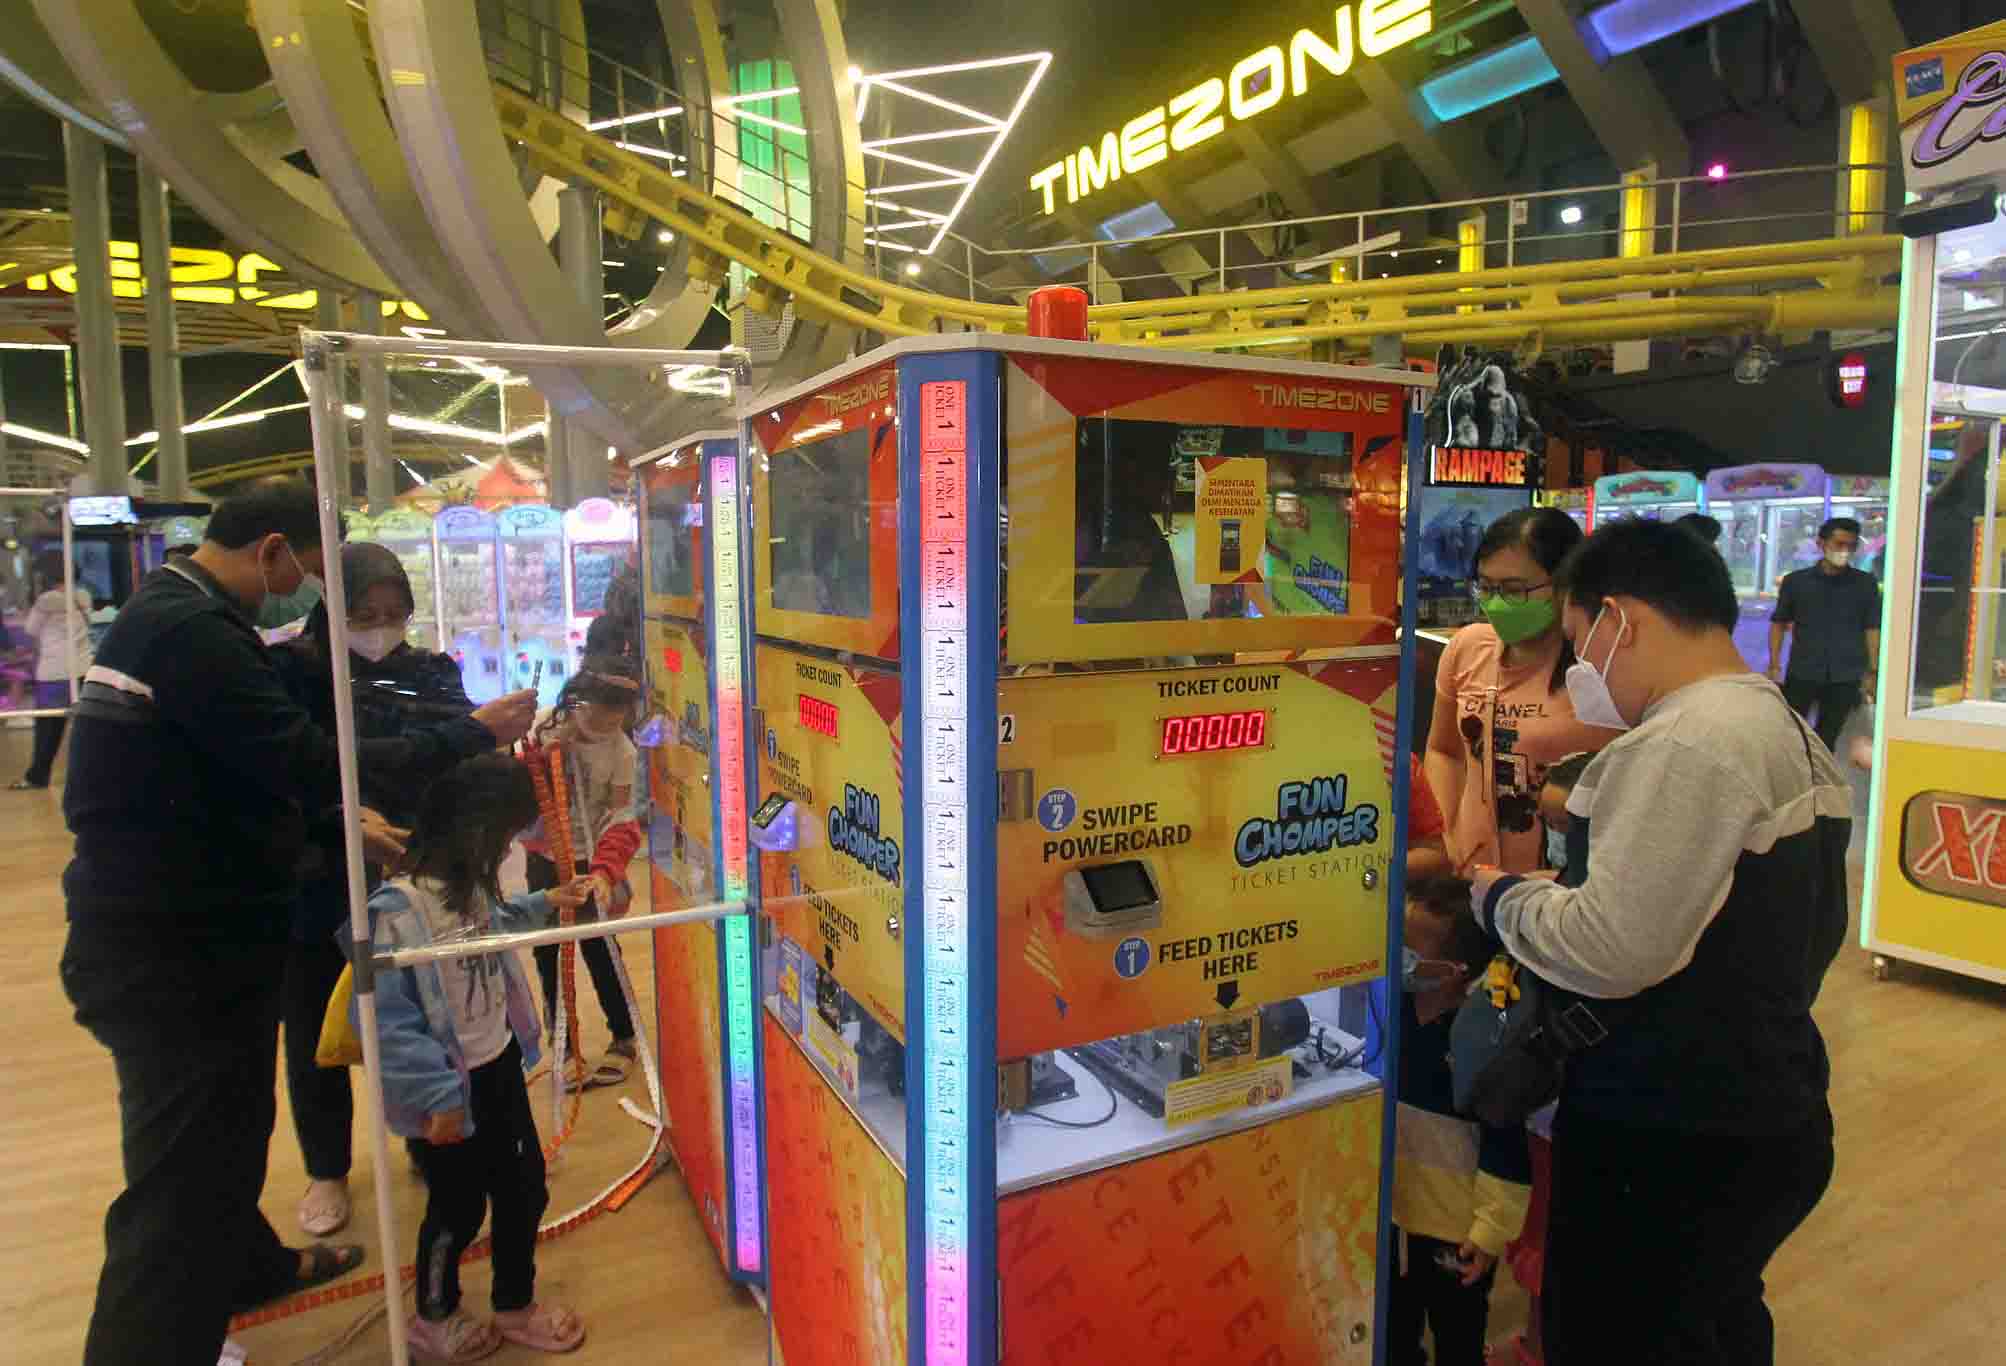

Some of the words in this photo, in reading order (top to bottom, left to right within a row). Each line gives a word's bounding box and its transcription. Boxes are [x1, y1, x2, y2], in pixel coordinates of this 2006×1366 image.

[1030, 0, 1432, 215] TIMEZONE
[935, 385, 944, 419] ICKET
[1252, 384, 1391, 413] TIMEZONE
[938, 420, 955, 429] 1
[938, 457, 955, 465] 1
[1436, 447, 1526, 484] RAMPAGE
[945, 478, 954, 502] ONE
[938, 511, 955, 519] 1
[938, 547, 955, 556] 1
[945, 567, 954, 591] ONE
[938, 600, 955, 608] 1
[938, 636, 955, 644] 1
[818, 669, 842, 689] COUNT
[935, 648, 944, 687] TICKET
[945, 656, 954, 680] ONE
[938, 689, 955, 697] 1
[1157, 679, 1220, 699] TICKET
[1223, 674, 1281, 694] COUNT
[938, 724, 955, 732] 1
[1000, 716, 1013, 743] 2
[1163, 711, 1264, 754] 00000
[935, 735, 944, 776] TICKET
[945, 743, 954, 768] ONE
[938, 776, 955, 784] 1
[845, 783, 880, 834] FUN
[1278, 773, 1347, 819] FUN
[938, 811, 955, 819] 1
[1052, 804, 1065, 829] 2
[1083, 802, 1158, 831] SWIPE
[828, 805, 900, 888] CHOMPER
[1043, 824, 1192, 864] POWERCARD
[1234, 804, 1380, 868] CHOMPER
[938, 861, 955, 869] 1
[1231, 866, 1297, 892] TICKET
[938, 895, 955, 903] 1
[818, 915, 841, 951] HERE
[823, 898, 859, 943] TICKETS
[938, 945, 955, 953] 1
[1158, 935, 1212, 964] FEED
[1217, 919, 1299, 951] TICKETS
[1203, 951, 1259, 981] HERE
[938, 978, 955, 986] 1
